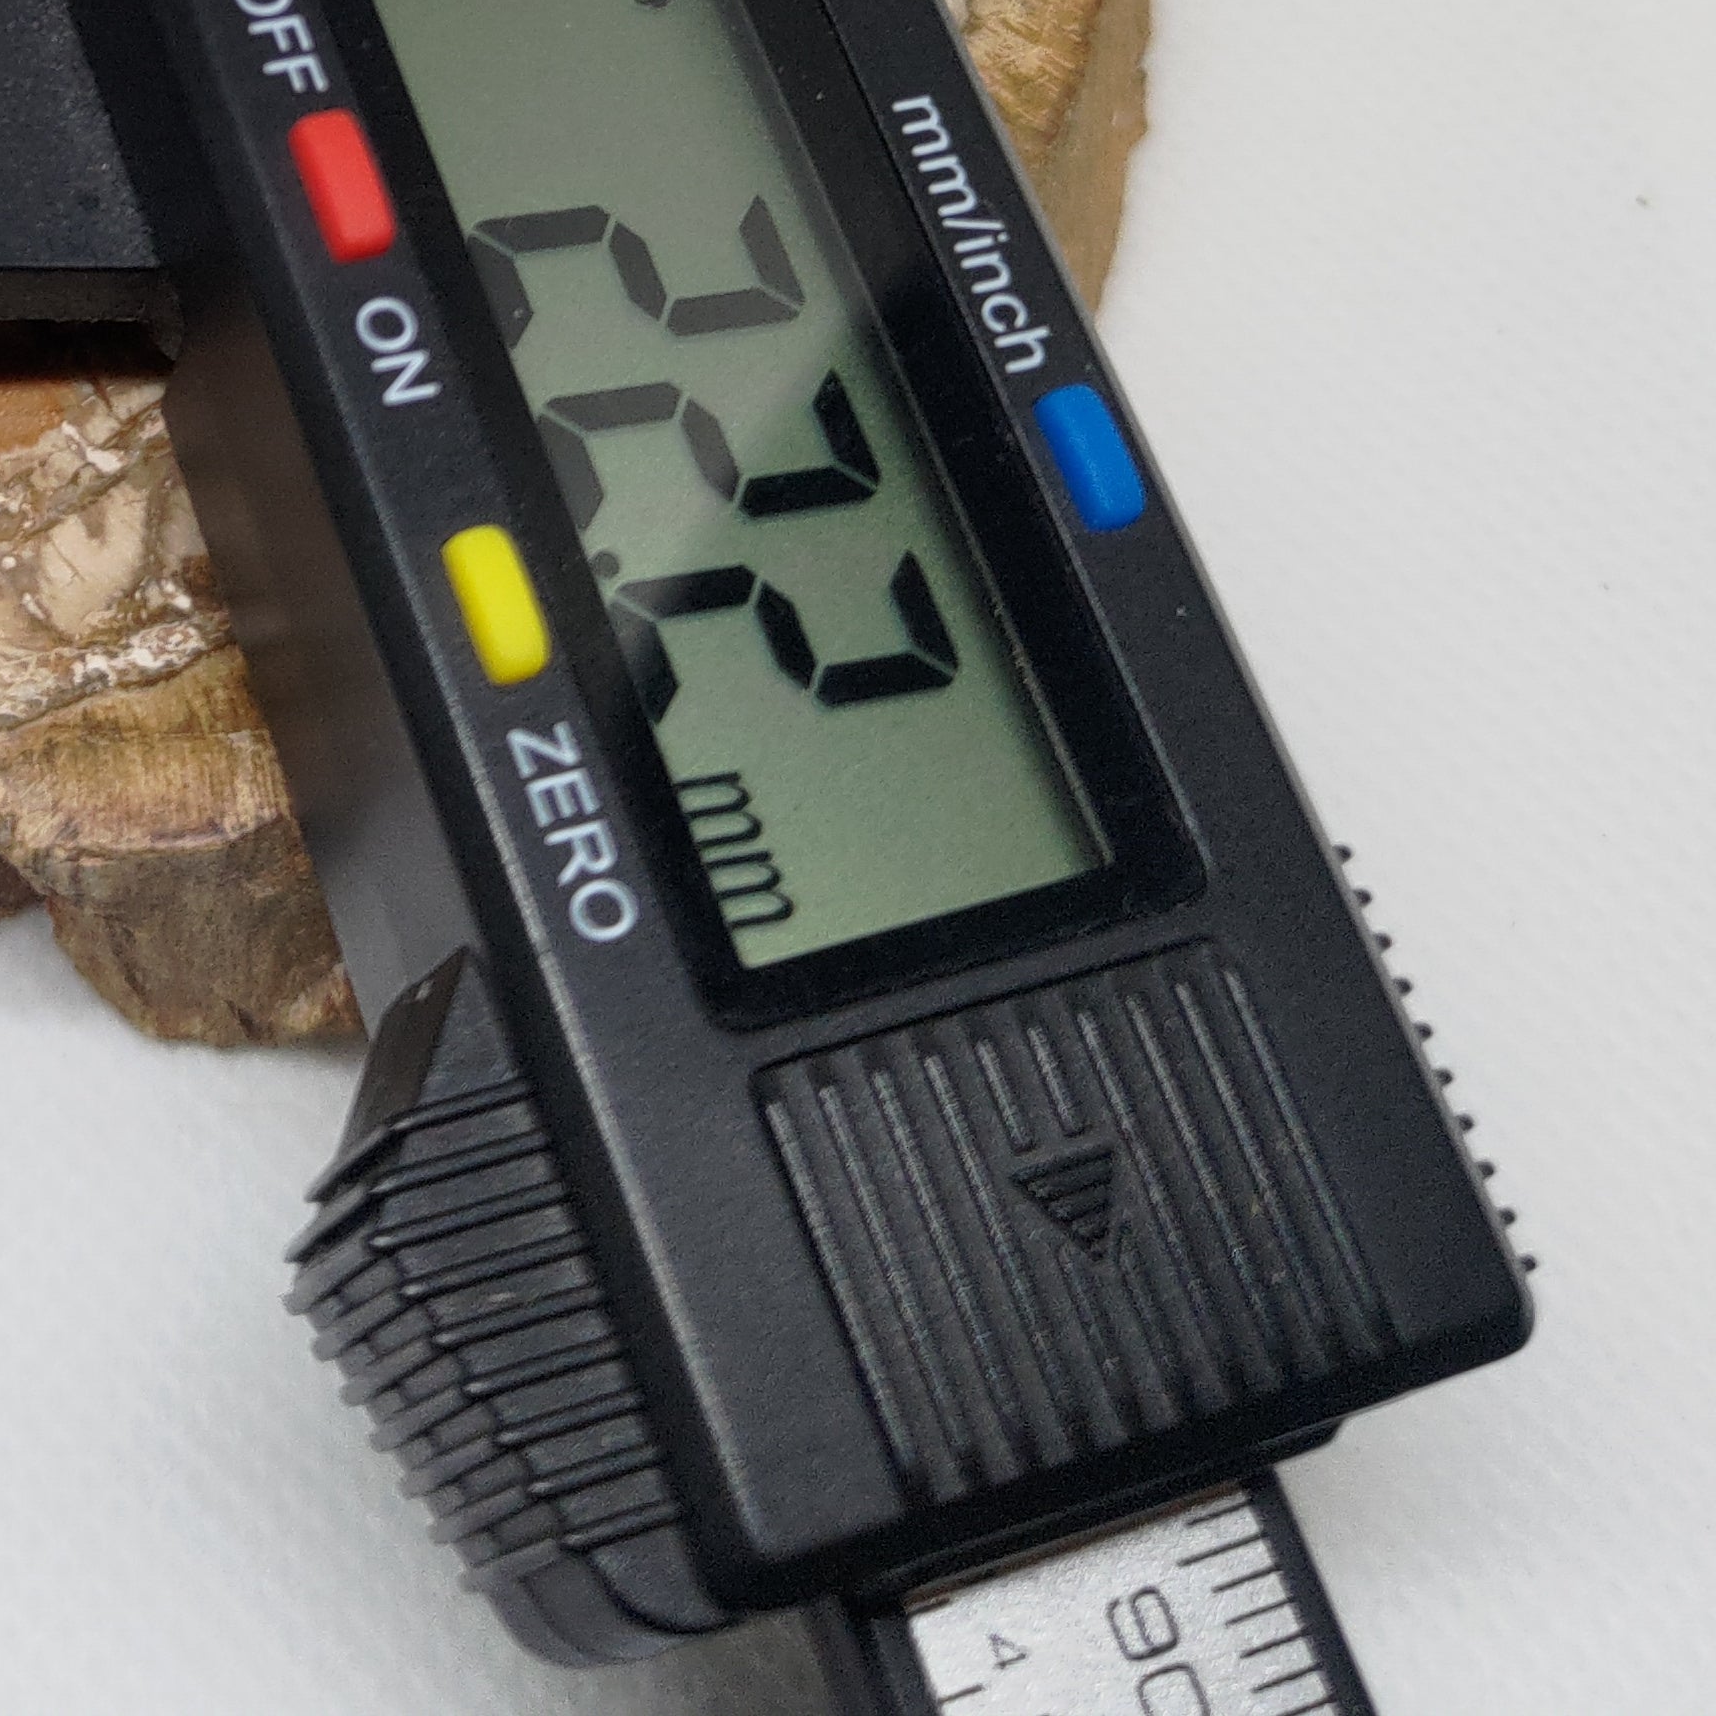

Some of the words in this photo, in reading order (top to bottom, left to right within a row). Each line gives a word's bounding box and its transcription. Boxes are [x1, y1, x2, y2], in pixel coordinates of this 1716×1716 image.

[891, 95, 1051, 374] mm/inch
[355, 296, 440, 405] ON
[468, 194, 959, 725] 22.2
[505, 721, 639, 943] ZERO
[672, 770, 796, 930] mm
[987, 1632, 1029, 1671] 4
